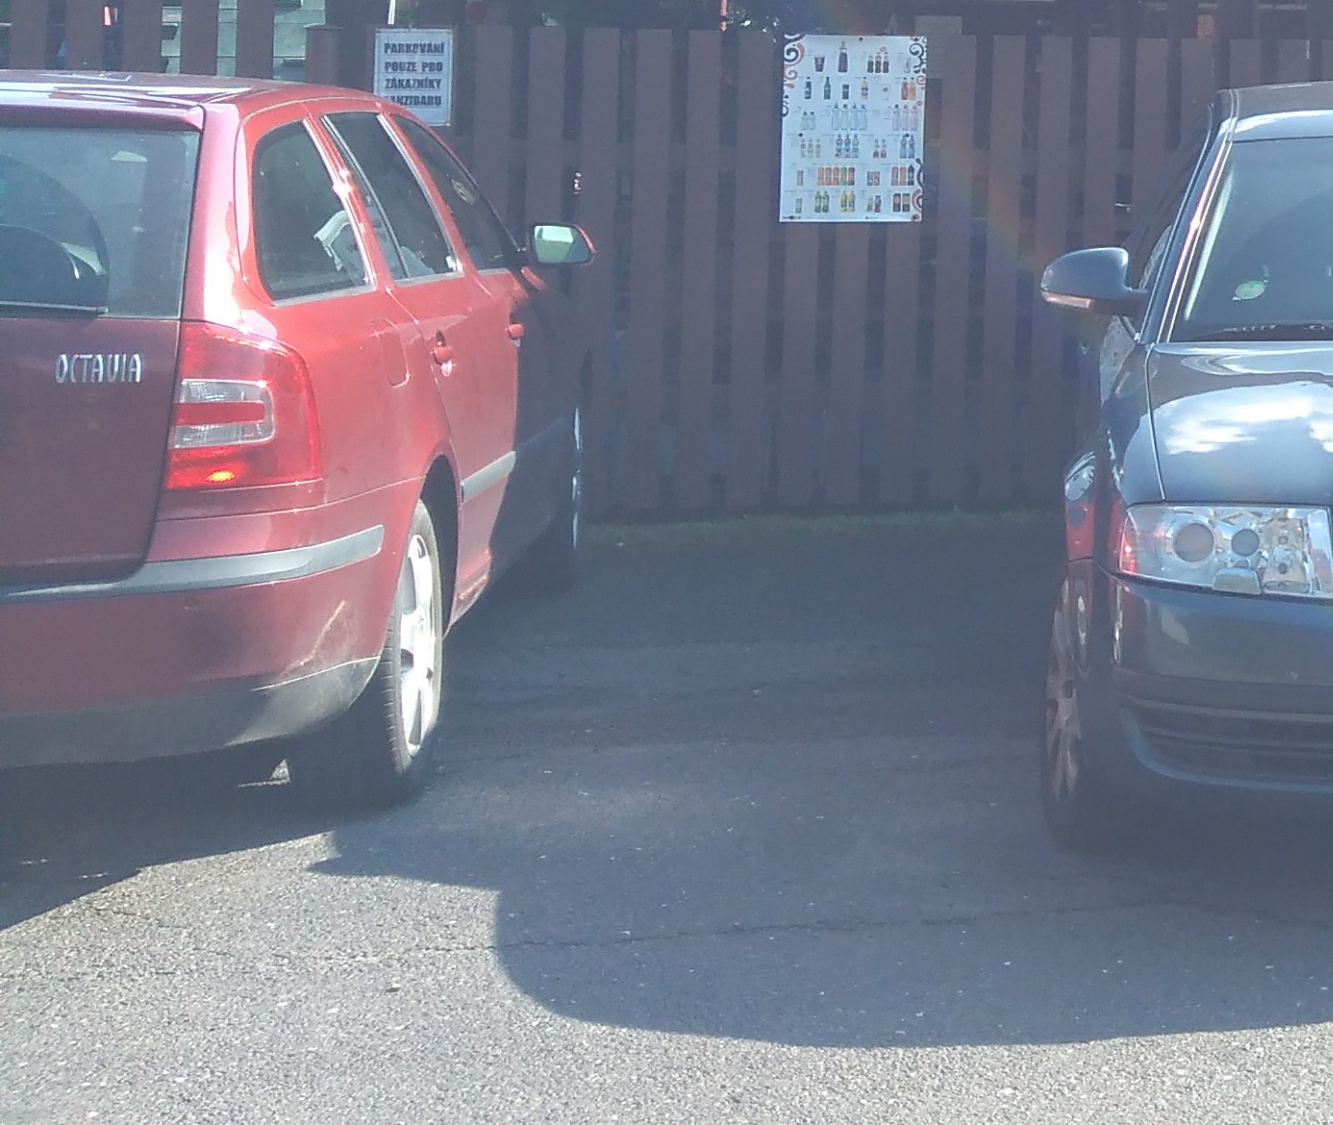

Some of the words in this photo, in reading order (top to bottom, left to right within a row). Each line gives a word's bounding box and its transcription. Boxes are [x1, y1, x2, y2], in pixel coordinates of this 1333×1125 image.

[384, 61, 418, 73] POUZE
[421, 61, 444, 73] PRO
[384, 76, 442, 90] ZÁKAZNÍKY
[54, 353, 144, 384] OCTAVIA
